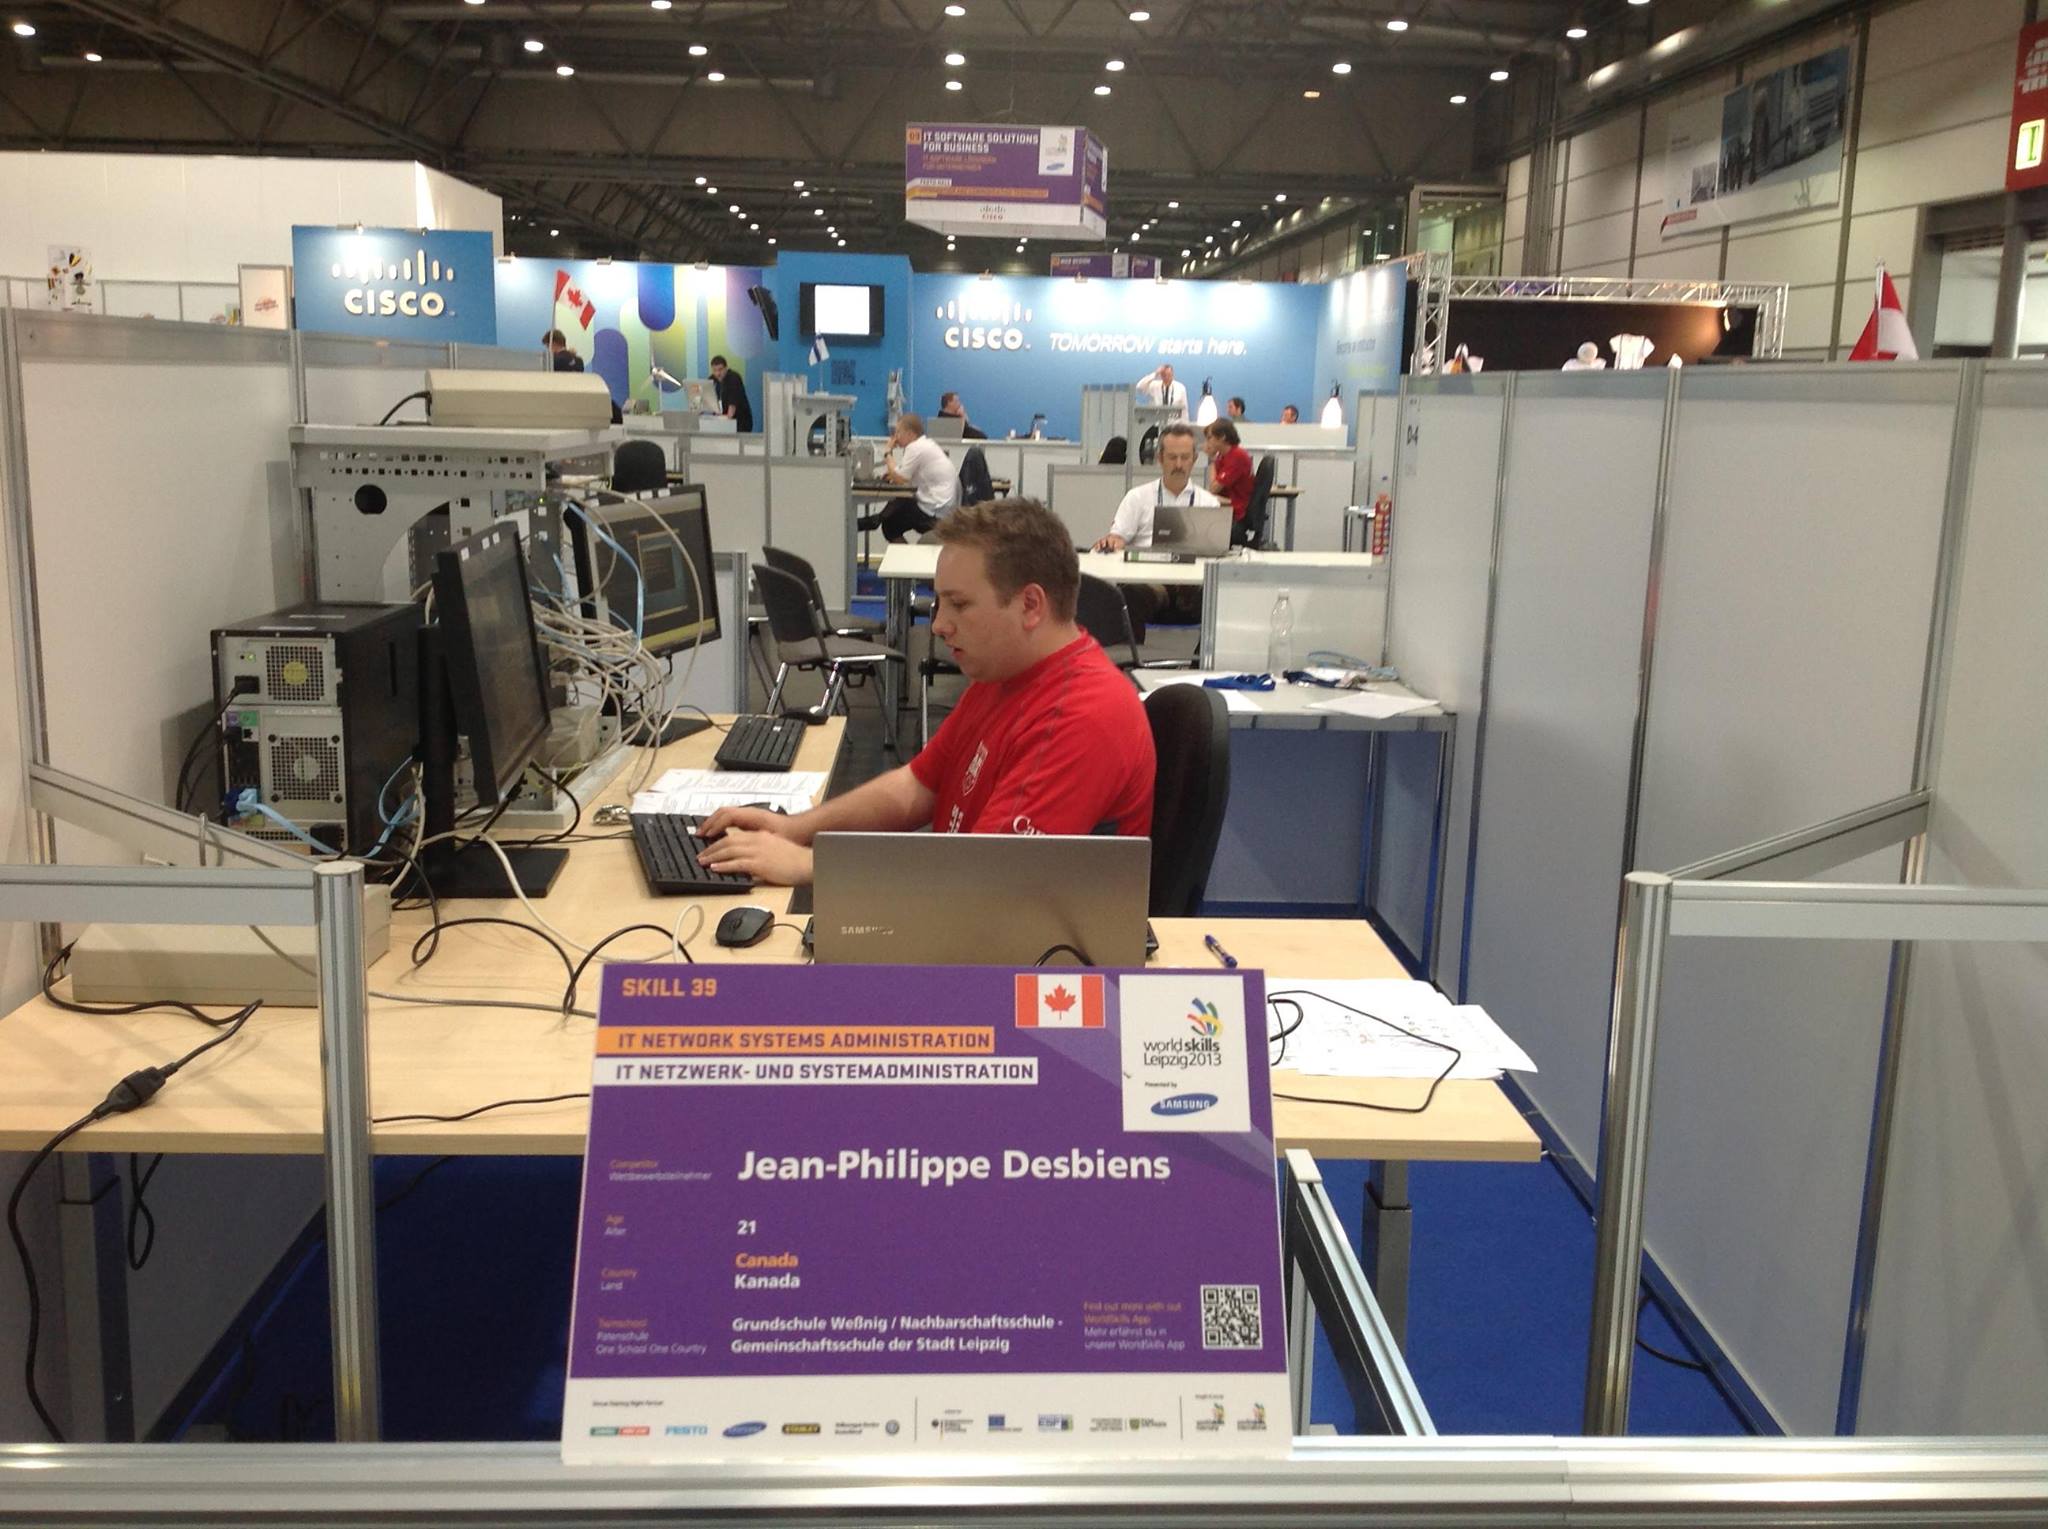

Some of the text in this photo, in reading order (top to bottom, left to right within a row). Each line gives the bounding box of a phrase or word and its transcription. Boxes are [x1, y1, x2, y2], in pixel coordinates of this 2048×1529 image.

[923, 131, 1039, 145] IT SOFTWARE SOLUTIONS
[923, 142, 990, 154] FOR BUSINESS
[344, 288, 445, 316] CISCO
[944, 327, 1024, 350] CISCO
[1049, 333, 1248, 356] TOMORROW starts here.
[622, 978, 718, 997] SKILL 39
[618, 1032, 991, 1048] IT NETWORK SYSTEMS ADMINISTRATION
[616, 1063, 1034, 1080] IT NETZWERK- UND SYSTEMADMINISTRATION
[1159, 1099, 1211, 1110] SAMSUNG
[737, 1147, 1172, 1187] Jean-Philippe Desbiens
[737, 1219, 757, 1236] 21
[735, 1252, 799, 1268] Canada
[734, 1273, 801, 1289] Kanada
[732, 1316, 827, 1332] Grundschule
[830, 1315, 888, 1333] Weßnig
[900, 1314, 1055, 1330] Nachbarschaftsschule
[731, 1336, 1010, 1354] Gemeinschaftsschule der Stadt Leipzig
